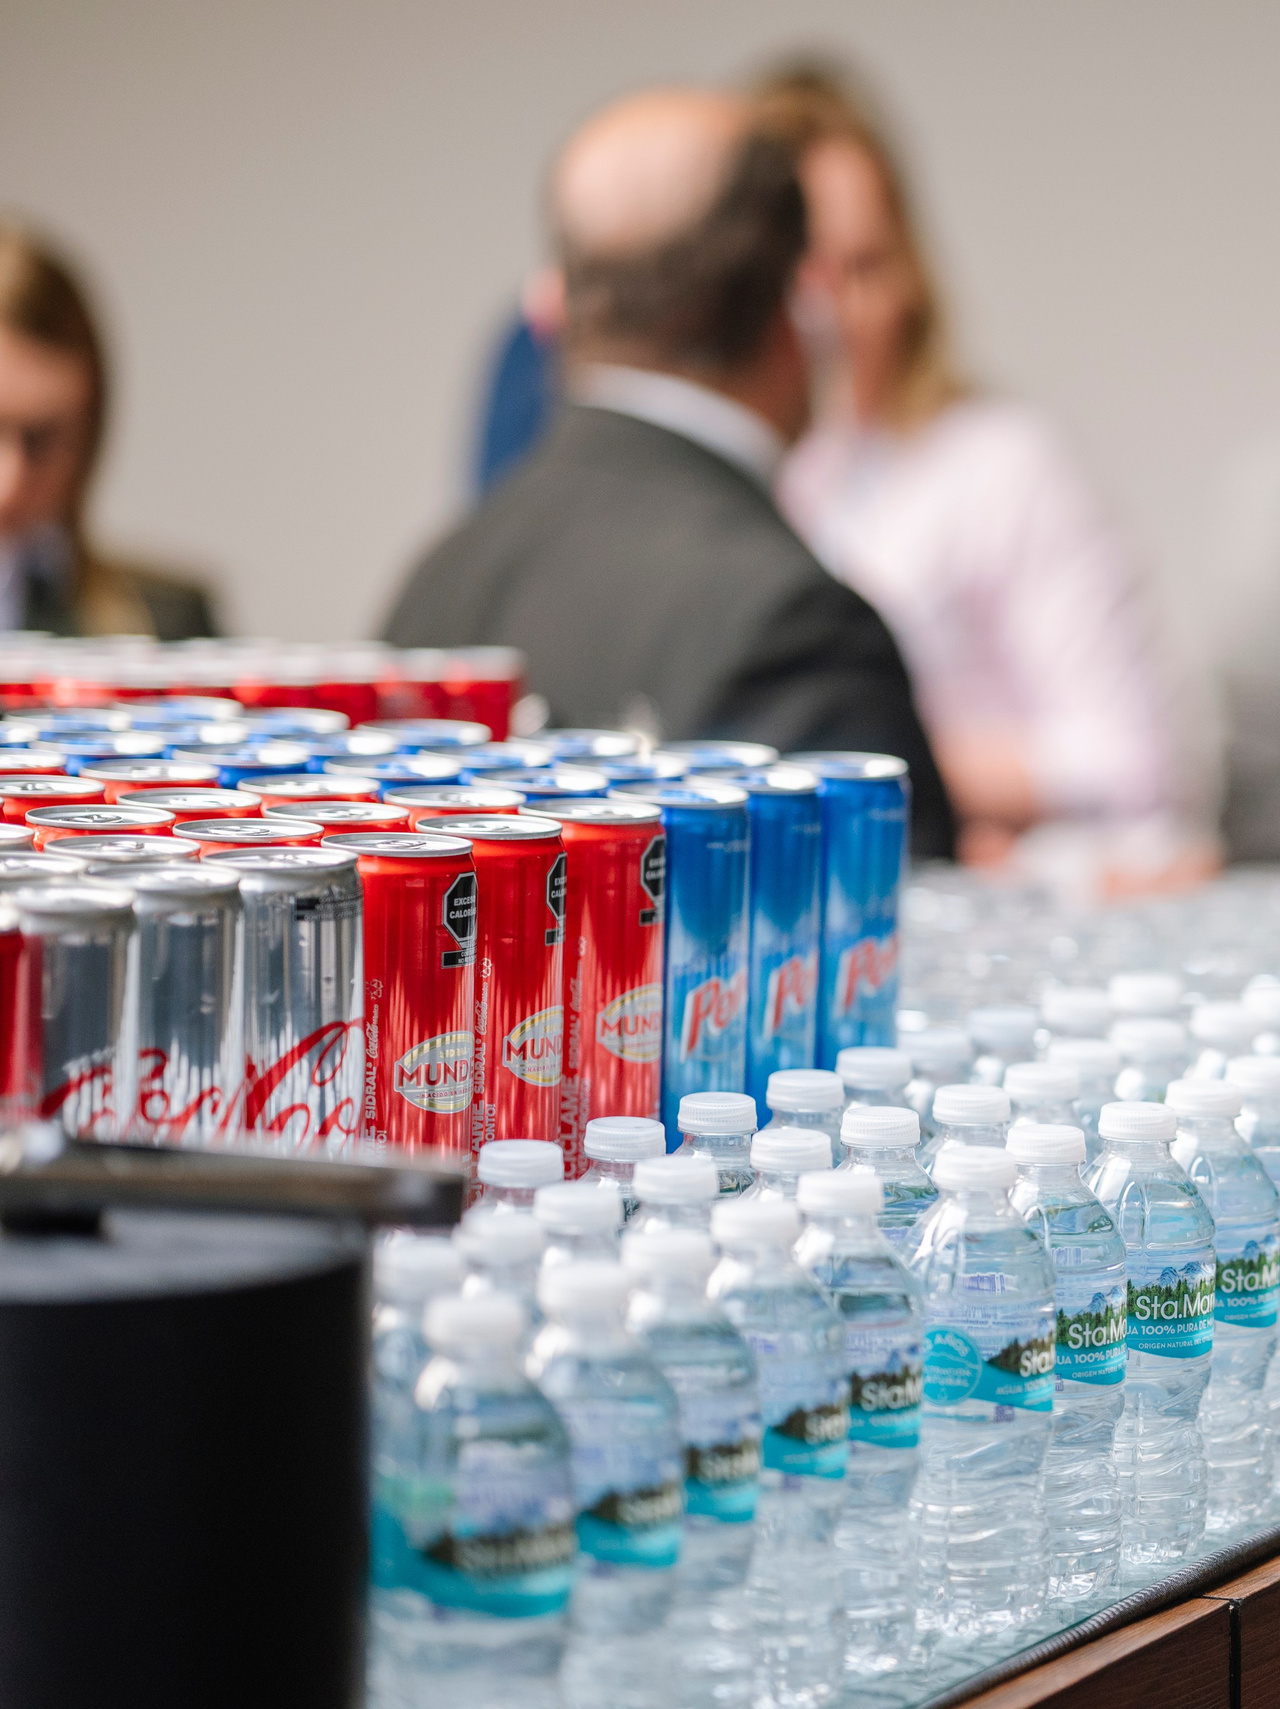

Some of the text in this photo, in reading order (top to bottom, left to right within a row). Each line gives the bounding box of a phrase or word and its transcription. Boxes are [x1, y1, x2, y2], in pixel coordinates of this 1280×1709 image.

[1141, 1324, 1175, 1336] 100%
[1177, 1323, 1198, 1334] PURA
[1138, 1341, 1166, 1350] ORIGEN
[1074, 1352, 1105, 1364] 100%
